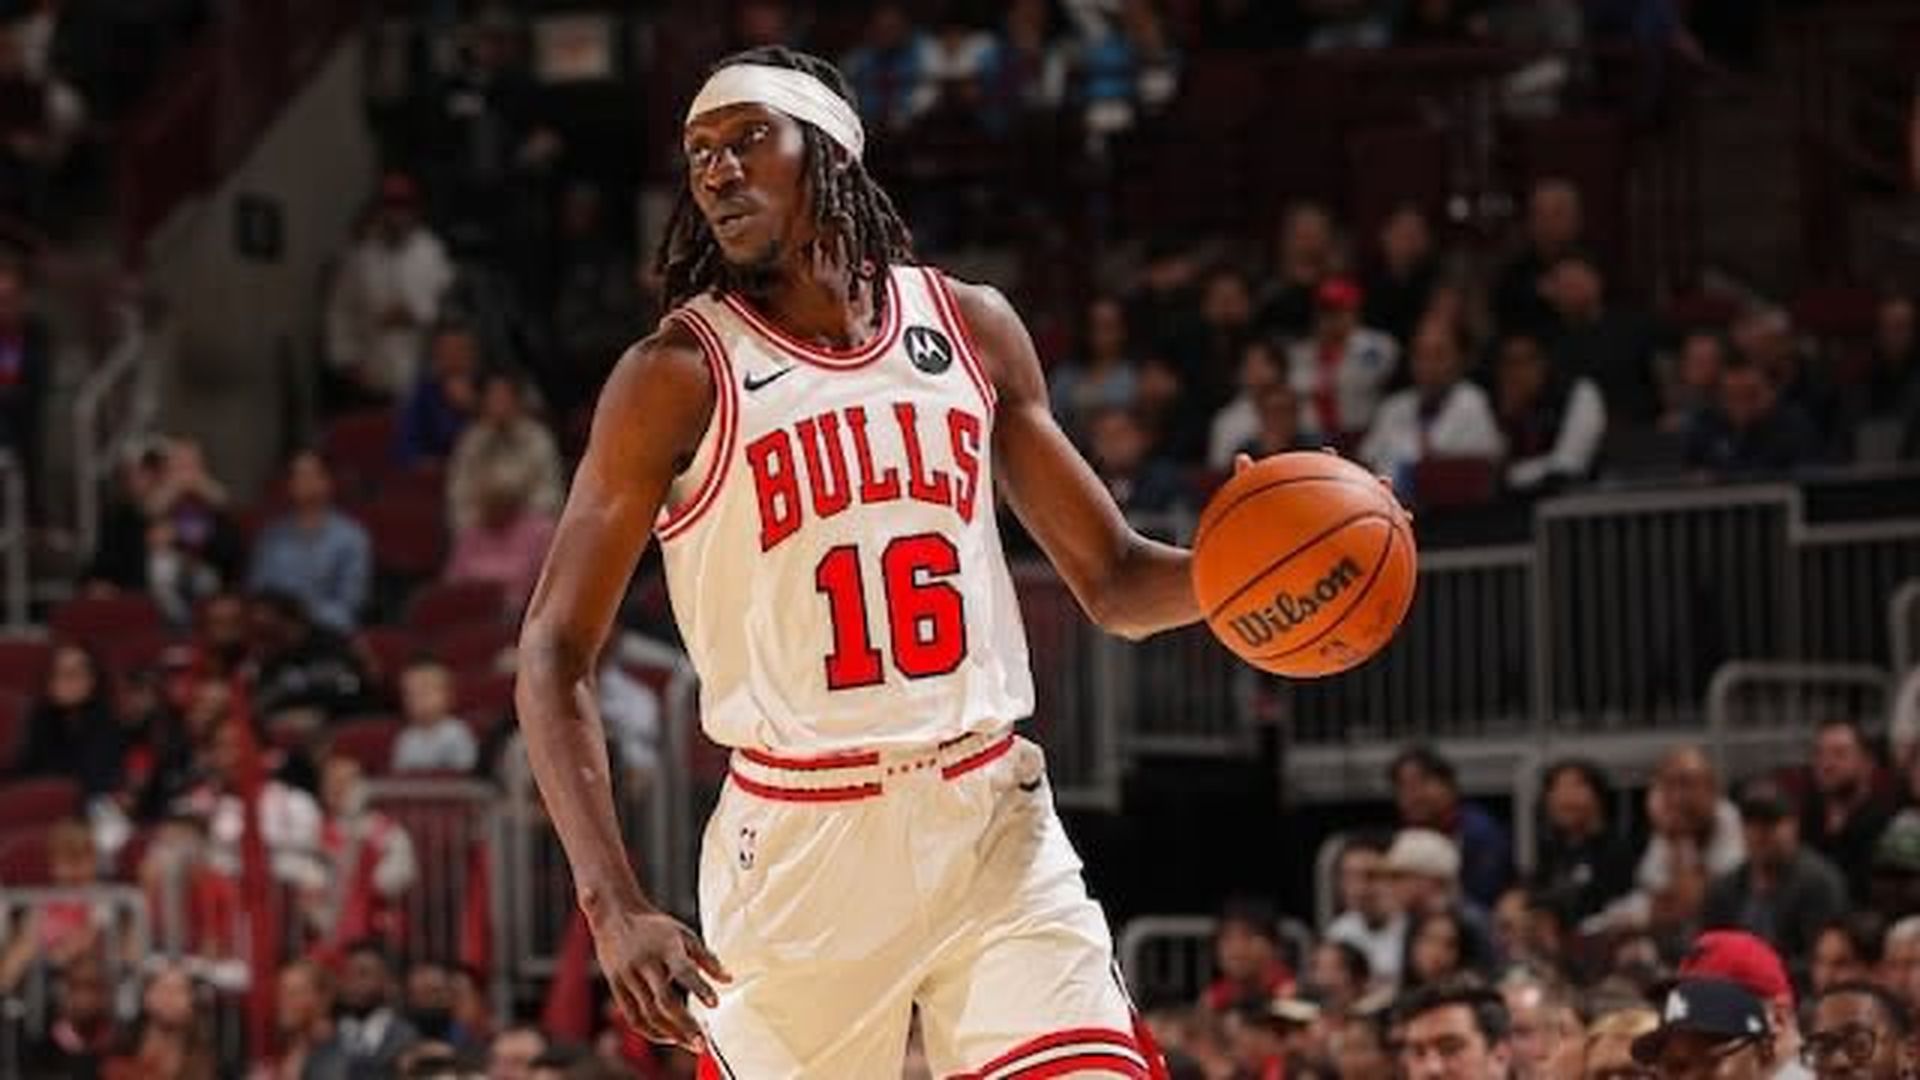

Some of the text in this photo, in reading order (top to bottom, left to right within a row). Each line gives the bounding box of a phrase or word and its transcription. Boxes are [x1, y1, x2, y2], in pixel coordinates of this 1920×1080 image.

[745, 402, 980, 553] BULLS
[815, 532, 968, 691] 16
[1228, 556, 1363, 647] Wilson
